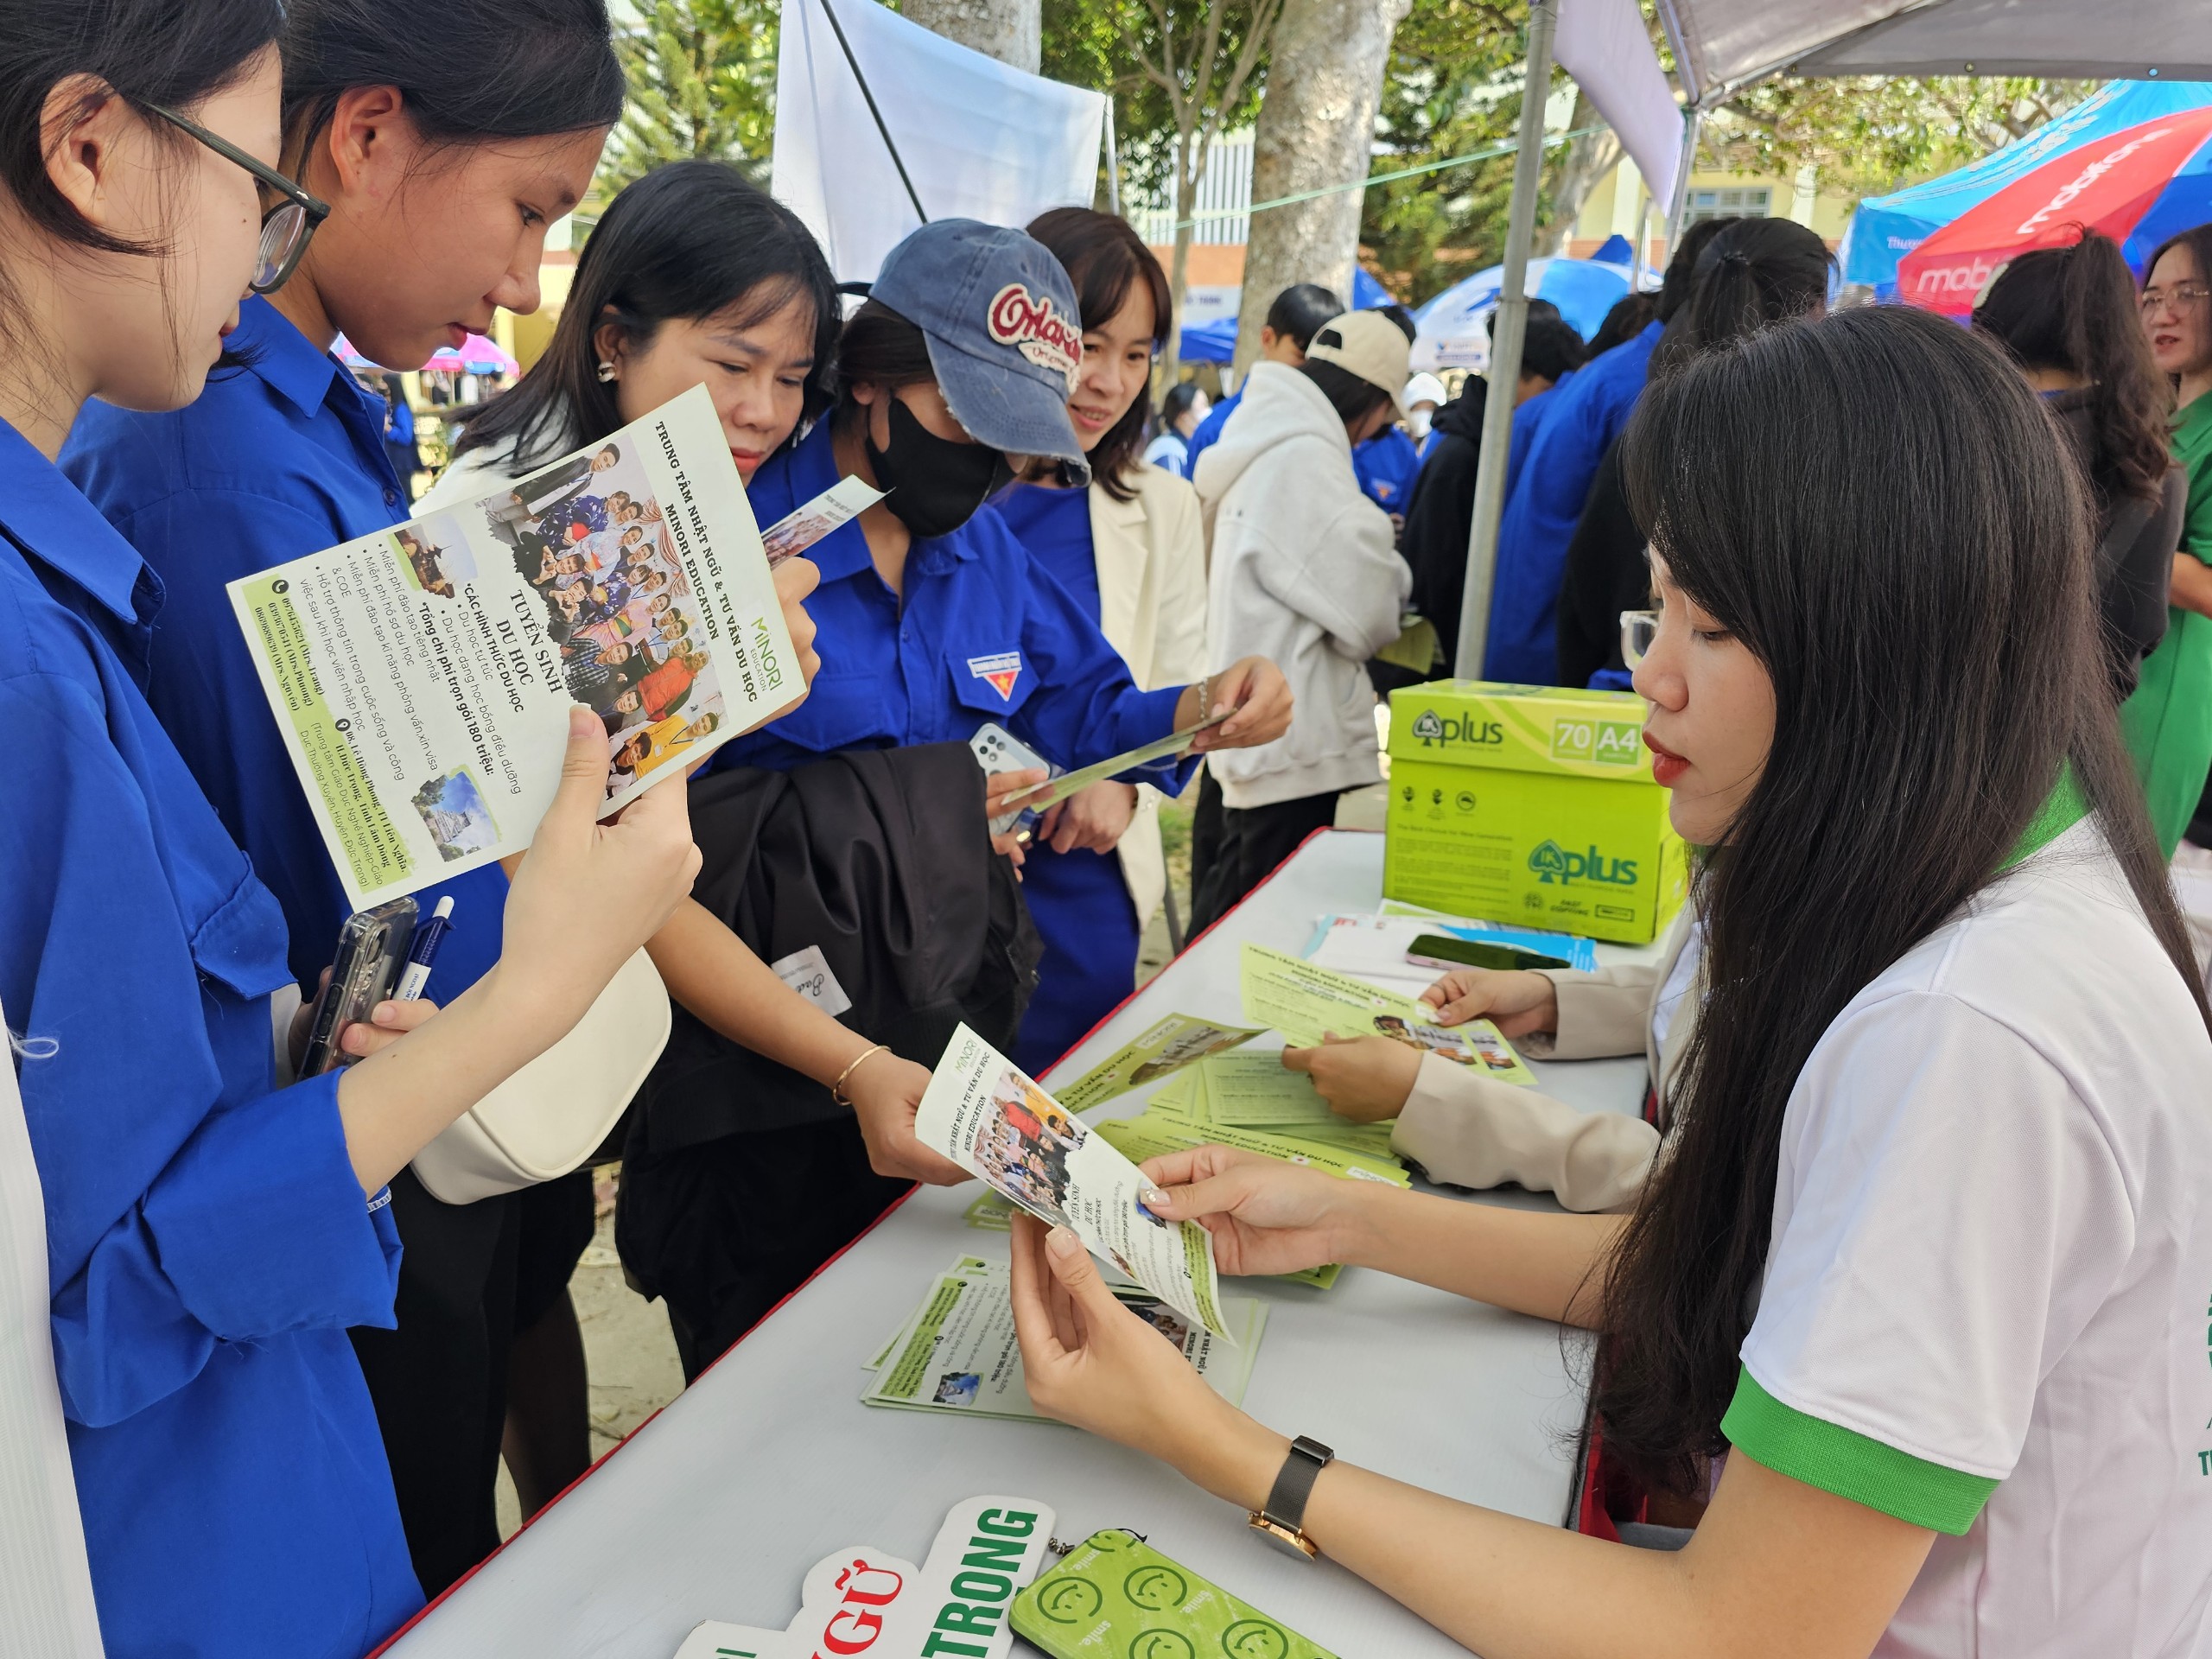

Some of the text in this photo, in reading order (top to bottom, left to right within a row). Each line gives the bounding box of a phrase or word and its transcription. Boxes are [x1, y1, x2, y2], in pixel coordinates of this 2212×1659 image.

[364, 556, 379, 582] Miễn
[654, 420, 758, 702] TRUNG TÂM NHẬT NGỮ & TƯ VẤN DU HỌC
[664, 503, 719, 640] MINORI EDUCATION
[331, 566, 352, 598] & COE
[372, 583, 391, 601] phí
[378, 550, 440, 683] Miễn phí đào tạo nhật
[388, 616, 401, 630] sơ
[394, 630, 406, 645] du
[430, 636, 448, 655] chi
[457, 611, 493, 680] Du học tự túc
[495, 619, 534, 685] DU HỌC
[509, 588, 563, 694] TUYỂN SINH
[750, 616, 783, 691] MINORI
[299, 578, 365, 731] việc sau khi học viên nhập học
[347, 561, 363, 587] Miễn
[356, 587, 373, 604] phí
[365, 605, 378, 624] đào
[372, 624, 385, 642] tạo
[385, 653, 401, 680] năng
[424, 749, 438, 771] visa
[400, 645, 415, 666] học
[435, 655, 456, 676] phí
[473, 609, 493, 639] HÌNH
[486, 638, 505, 671] THỨC
[499, 670, 513, 687] DU
[506, 687, 524, 713] HỌC
[749, 646, 767, 692] EDUCATION
[315, 572, 404, 781] Hỗ trợ thông tin trong cuộc sống và công
[447, 676, 463, 702] trọn
[441, 616, 454, 633] Du
[448, 633, 463, 655] học
[457, 655, 474, 683] dạng
[469, 683, 484, 704] học
[500, 759, 521, 794] dưỡng
[455, 702, 475, 721] gói
[466, 720, 482, 742] 180
[1439, 711, 1503, 750] plus
[1556, 722, 1638, 753] 70 A4
[310, 721, 327, 750] (Trung
[322, 749, 334, 768] tâm
[330, 768, 343, 788] Giáo
[338, 788, 351, 807] Dục
[475, 743, 493, 775] triệu:
[299, 729, 311, 747] Dục
[343, 838, 356, 858] Đức
[1561, 844, 1638, 886] plus
[973, 1065, 984, 1078] DU
[979, 1052, 990, 1067] HỌC
[966, 1094, 988, 1133] EDUCATION
[1069, 1182, 1082, 1202] SINH
[1081, 1210, 1094, 1225] DU
[1185, 1331, 1197, 1355] MINORI
[1071, 1548, 1102, 1571] smile.
[811, 1559, 903, 1658] GỮ
[1179, 1588, 1211, 1614] smile.
[1078, 1619, 1112, 1646] smile.
